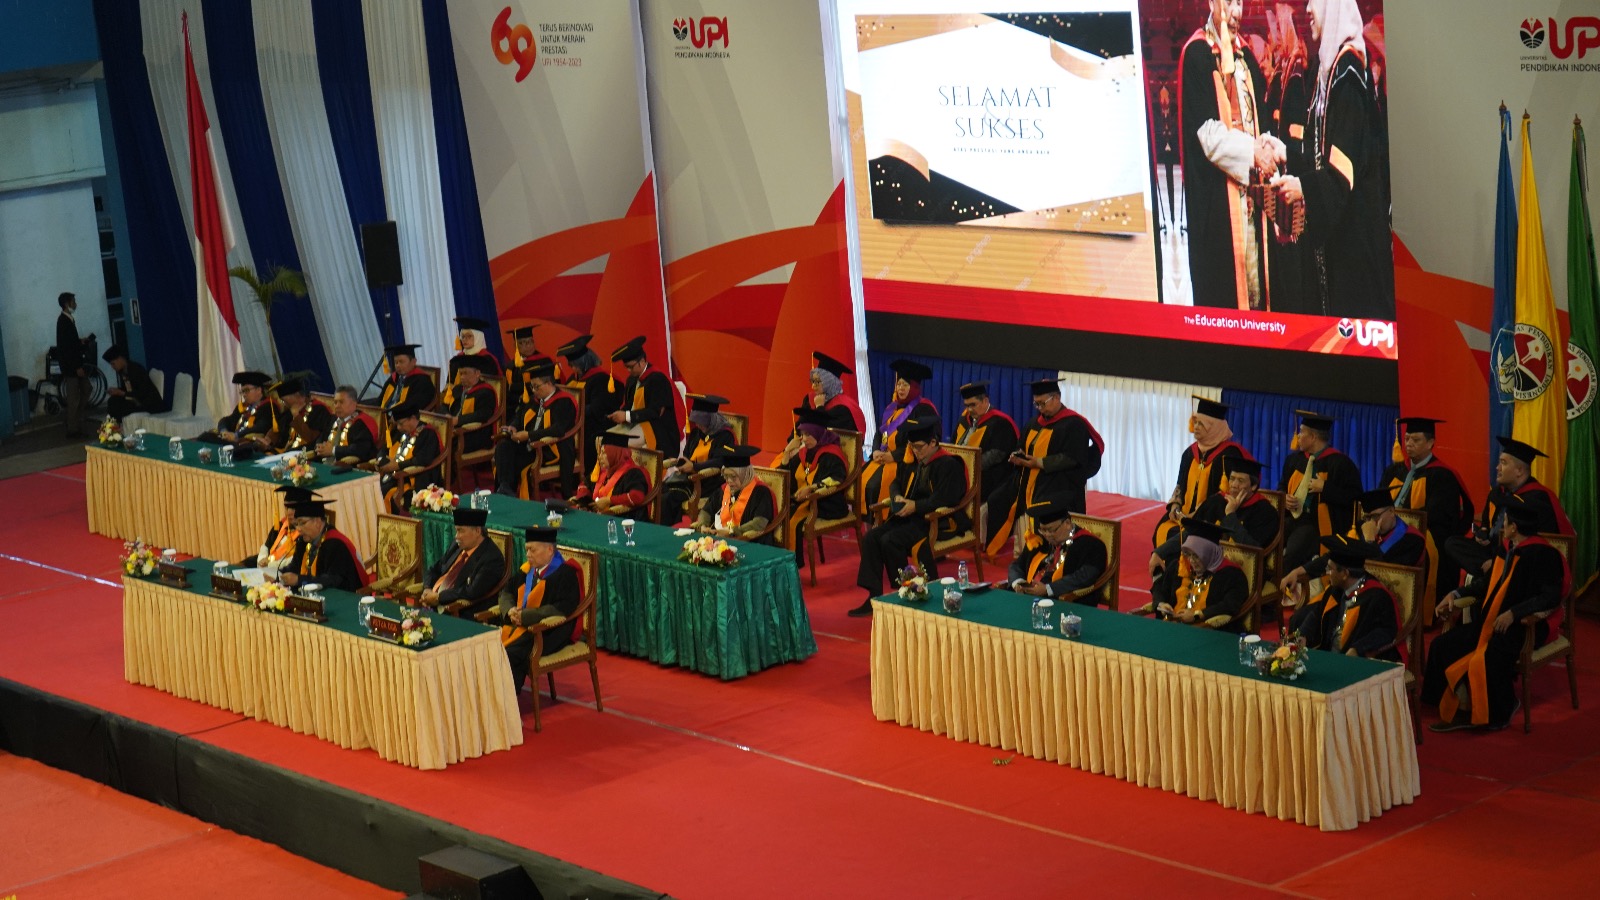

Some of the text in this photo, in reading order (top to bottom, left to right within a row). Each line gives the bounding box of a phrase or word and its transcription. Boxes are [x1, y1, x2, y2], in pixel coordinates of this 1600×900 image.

[539, 23, 594, 32] TERUS BERINOVASI
[689, 16, 729, 49] UPI
[540, 34, 586, 43] UNTUK MERAIH
[541, 45, 568, 55] PRESTASI
[541, 57, 582, 67] UPI 1954-2023
[1520, 63, 1569, 72] PENDIDIKAN
[938, 85, 1057, 108] SELAMAT
[955, 116, 1044, 140] SUKSES
[1184, 313, 1286, 335] The Education University
[1356, 319, 1394, 348] UPI
